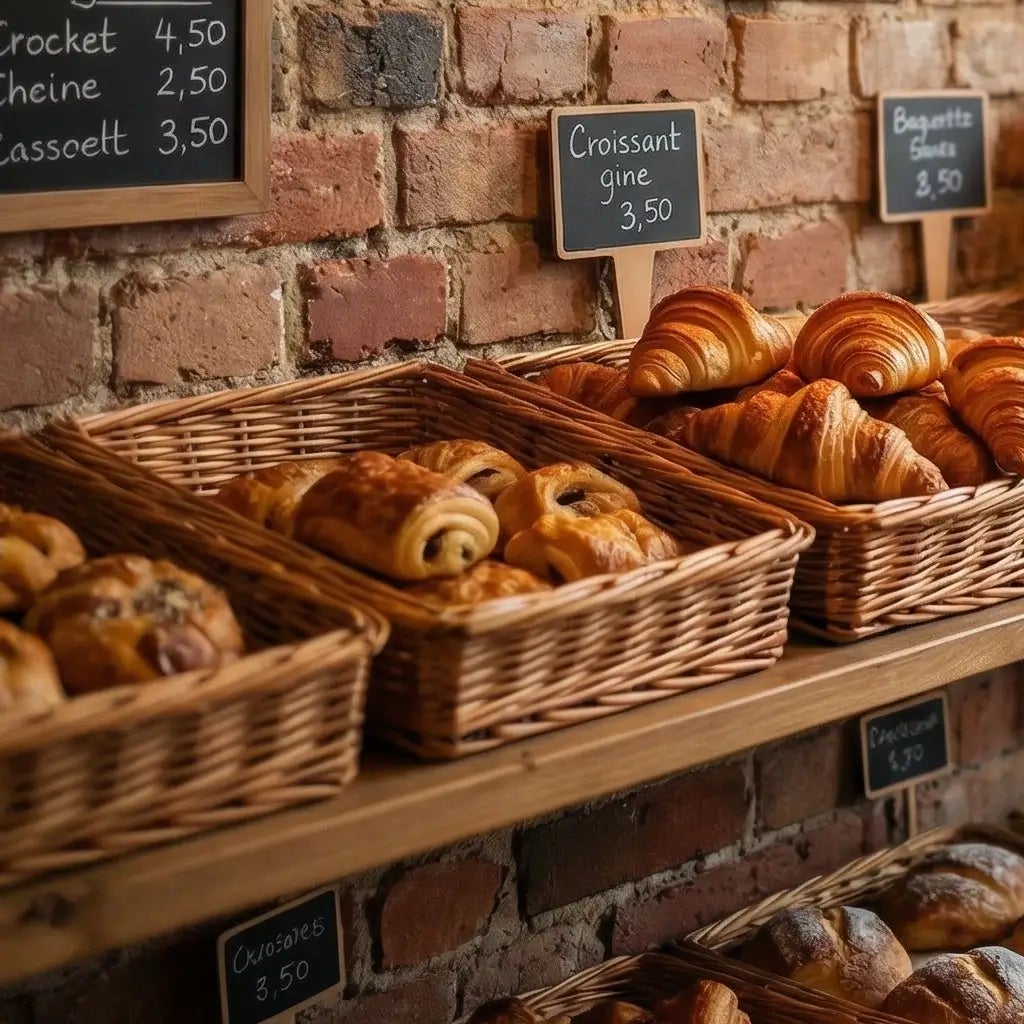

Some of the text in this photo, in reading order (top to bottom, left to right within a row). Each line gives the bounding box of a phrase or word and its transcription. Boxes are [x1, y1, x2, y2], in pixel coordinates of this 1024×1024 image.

[155, 18, 226, 55] 4,50
[156, 66, 227, 102] 2,50
[158, 116, 229, 156] 3,50
[569, 121, 682, 159] Croissant
[600, 164, 652, 205] gine
[620, 198, 672, 233] 3,50
[256, 960, 309, 1002] 3,50
